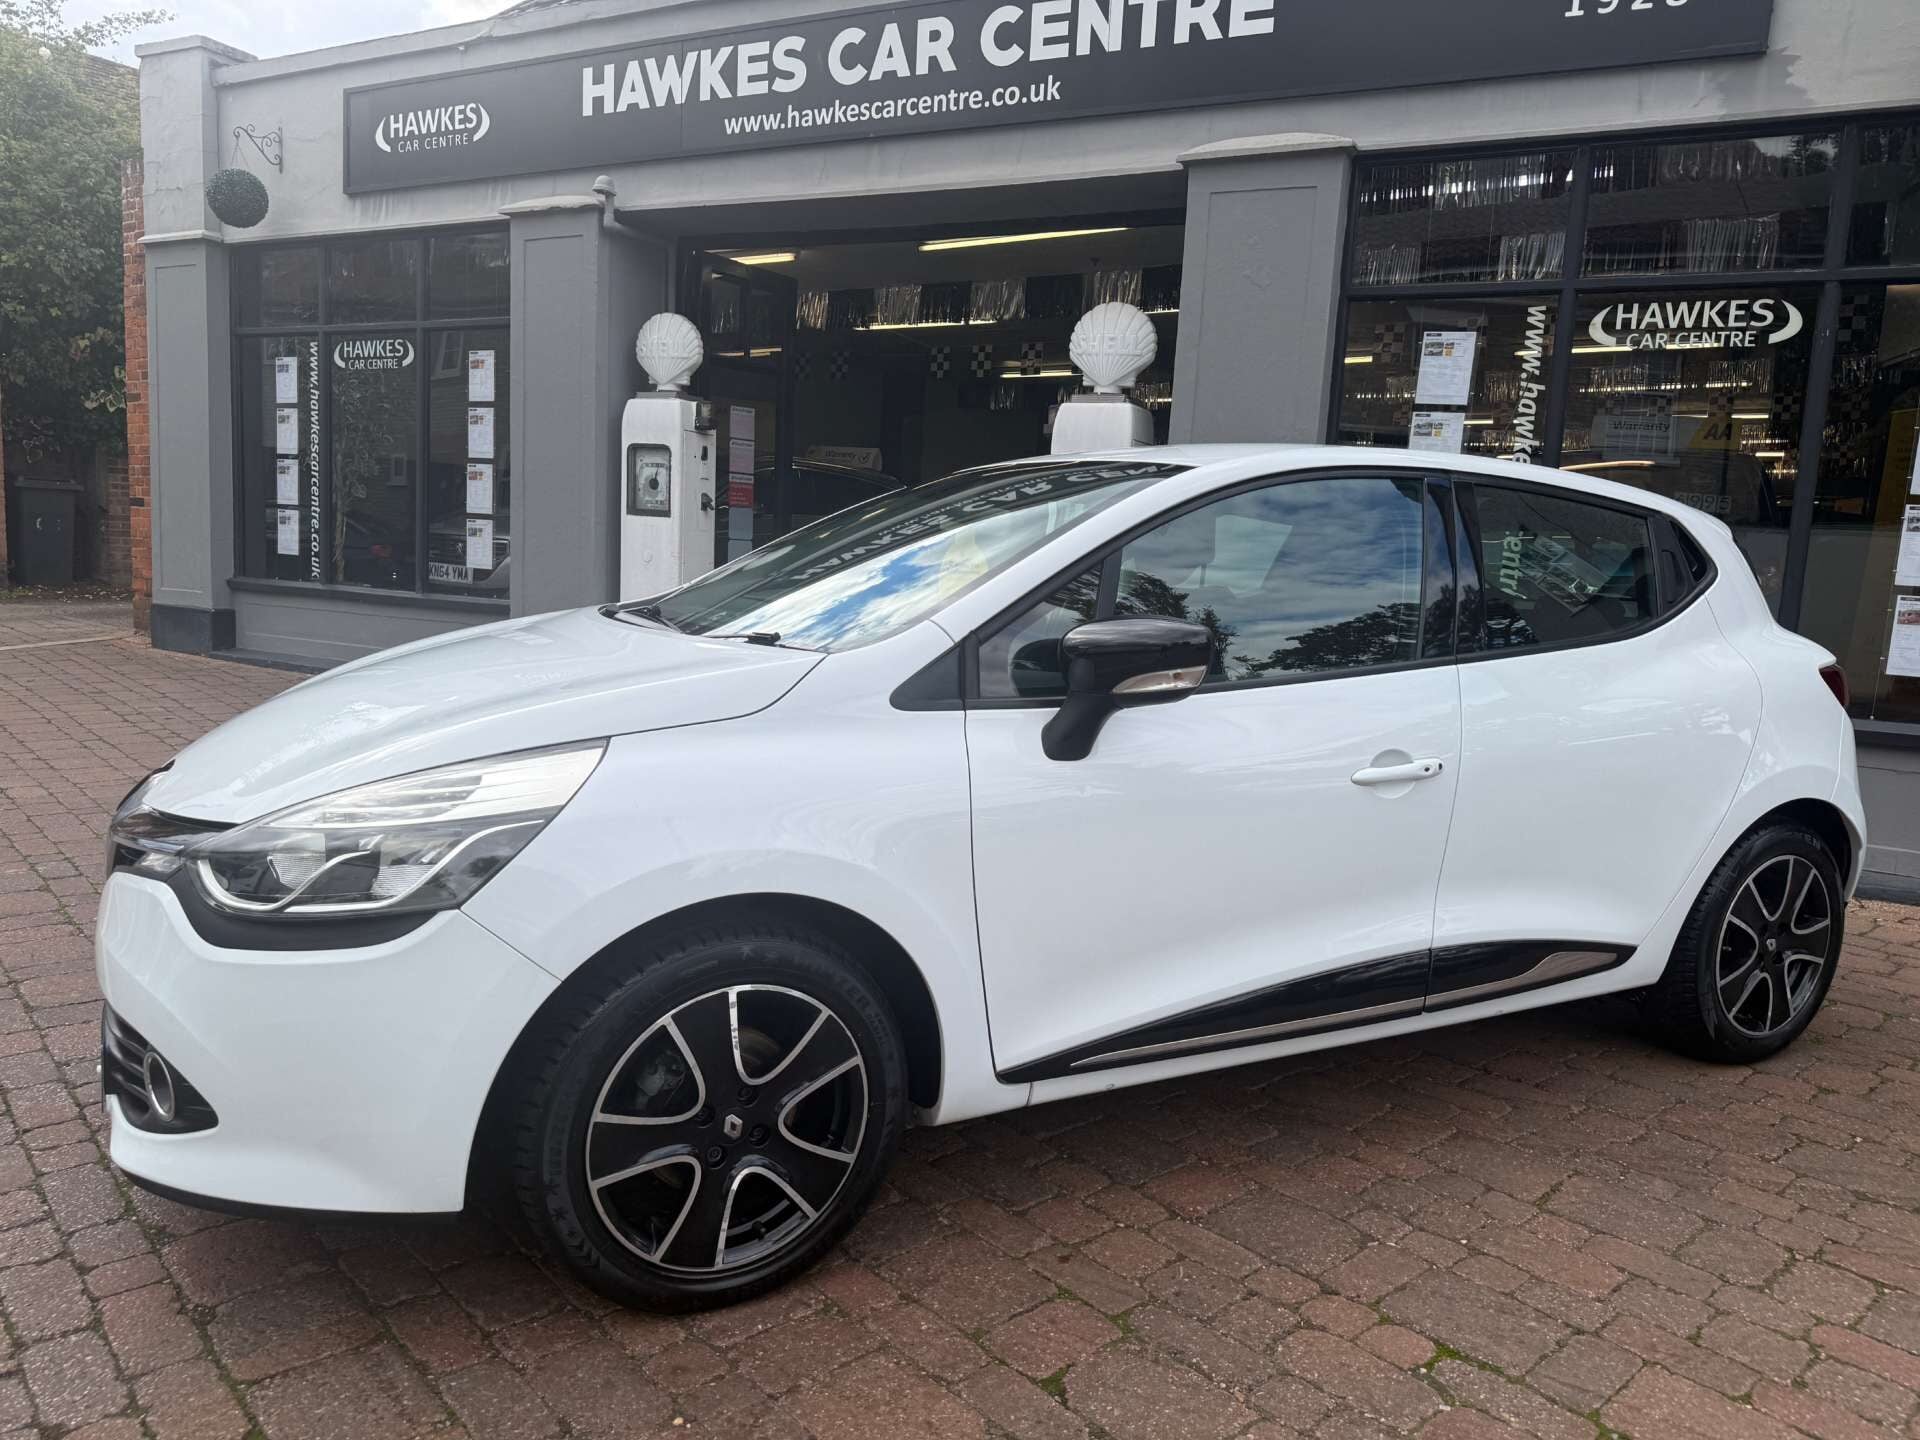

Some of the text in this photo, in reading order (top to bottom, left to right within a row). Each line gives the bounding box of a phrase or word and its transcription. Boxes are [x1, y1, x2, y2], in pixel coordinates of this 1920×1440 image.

[582, 0, 1274, 116] HAWKES CAR CENTRE
[724, 75, 1061, 134] www.hawkescarcentre.co.uk
[390, 102, 477, 138] HAWKES
[398, 132, 469, 153] CAR CENTRE
[1615, 298, 1775, 330] HAWKES
[343, 339, 405, 358] HAWKES
[1076, 334, 1141, 355] SHELL
[1625, 330, 1757, 350] CAR CENTRE
[348, 358, 399, 370] CAR CENTRE
[1613, 421, 1670, 433] Warranty
[1703, 423, 1732, 441] AA
[309, 341, 321, 580] www.hawkescarcentre.co.uk
